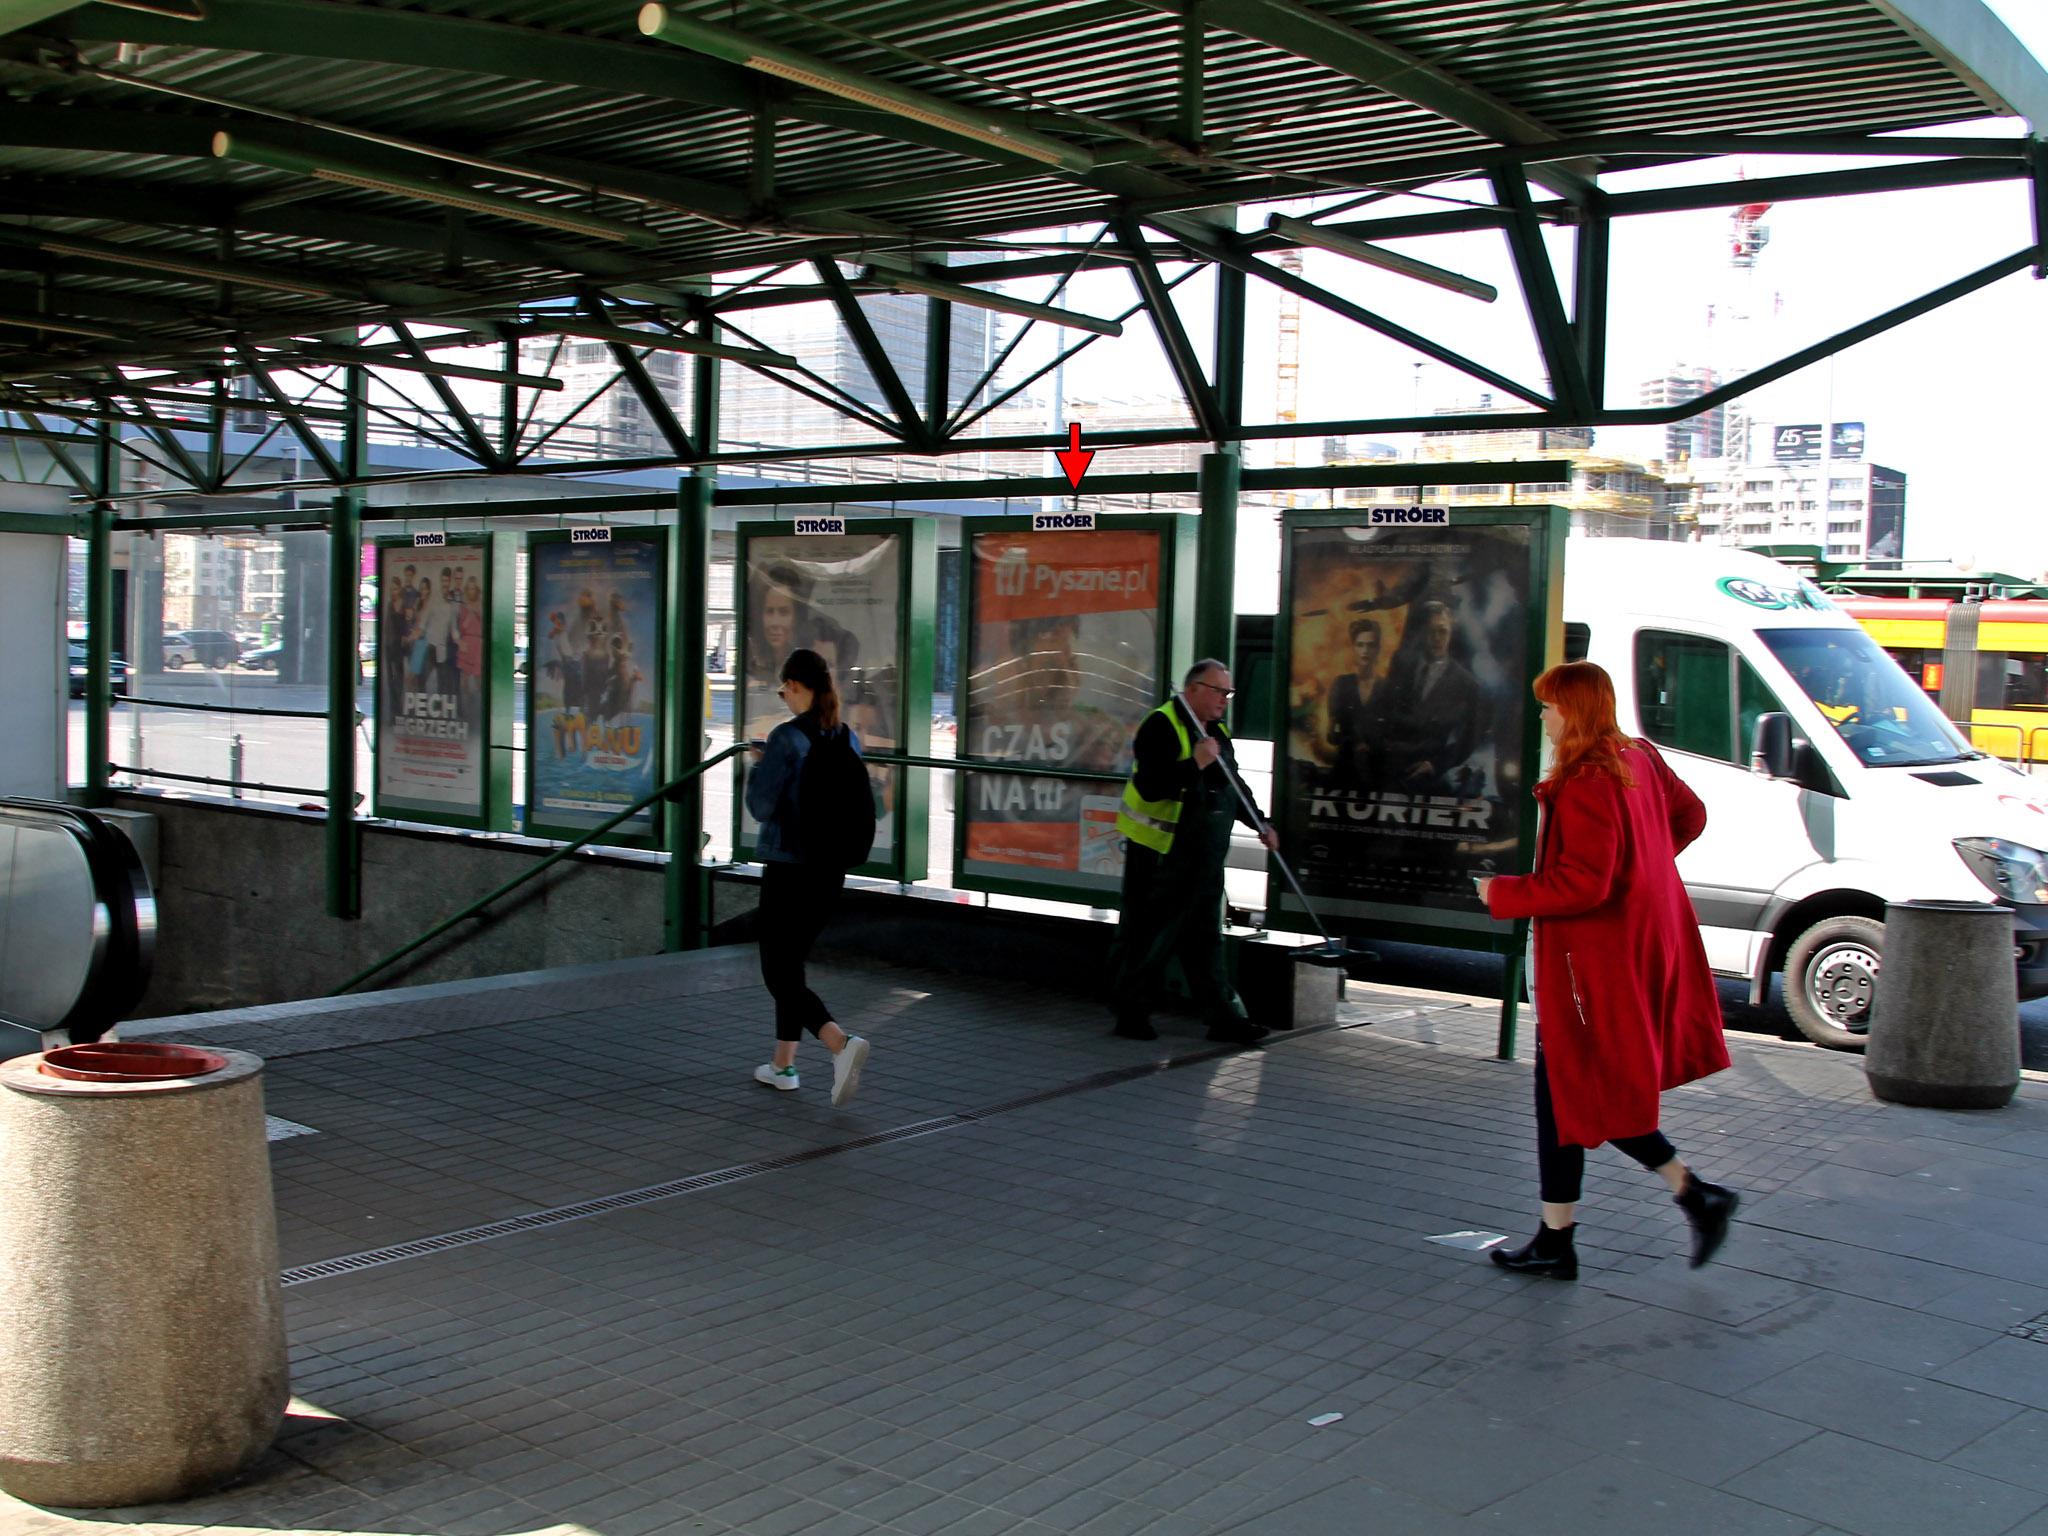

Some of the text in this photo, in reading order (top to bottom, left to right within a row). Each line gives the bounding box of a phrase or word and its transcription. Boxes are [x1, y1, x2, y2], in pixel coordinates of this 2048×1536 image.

[797, 518, 843, 532] STRÖER
[1035, 513, 1092, 529] STRÖER
[1372, 507, 1446, 523] STRÖER
[573, 528, 609, 540] STRÖER
[1034, 563, 1149, 599] Pyszne.pl
[403, 691, 457, 719] PECH
[981, 721, 1073, 763] CZAS
[979, 774, 1028, 811] NA
[1310, 787, 1493, 830] KURIER
